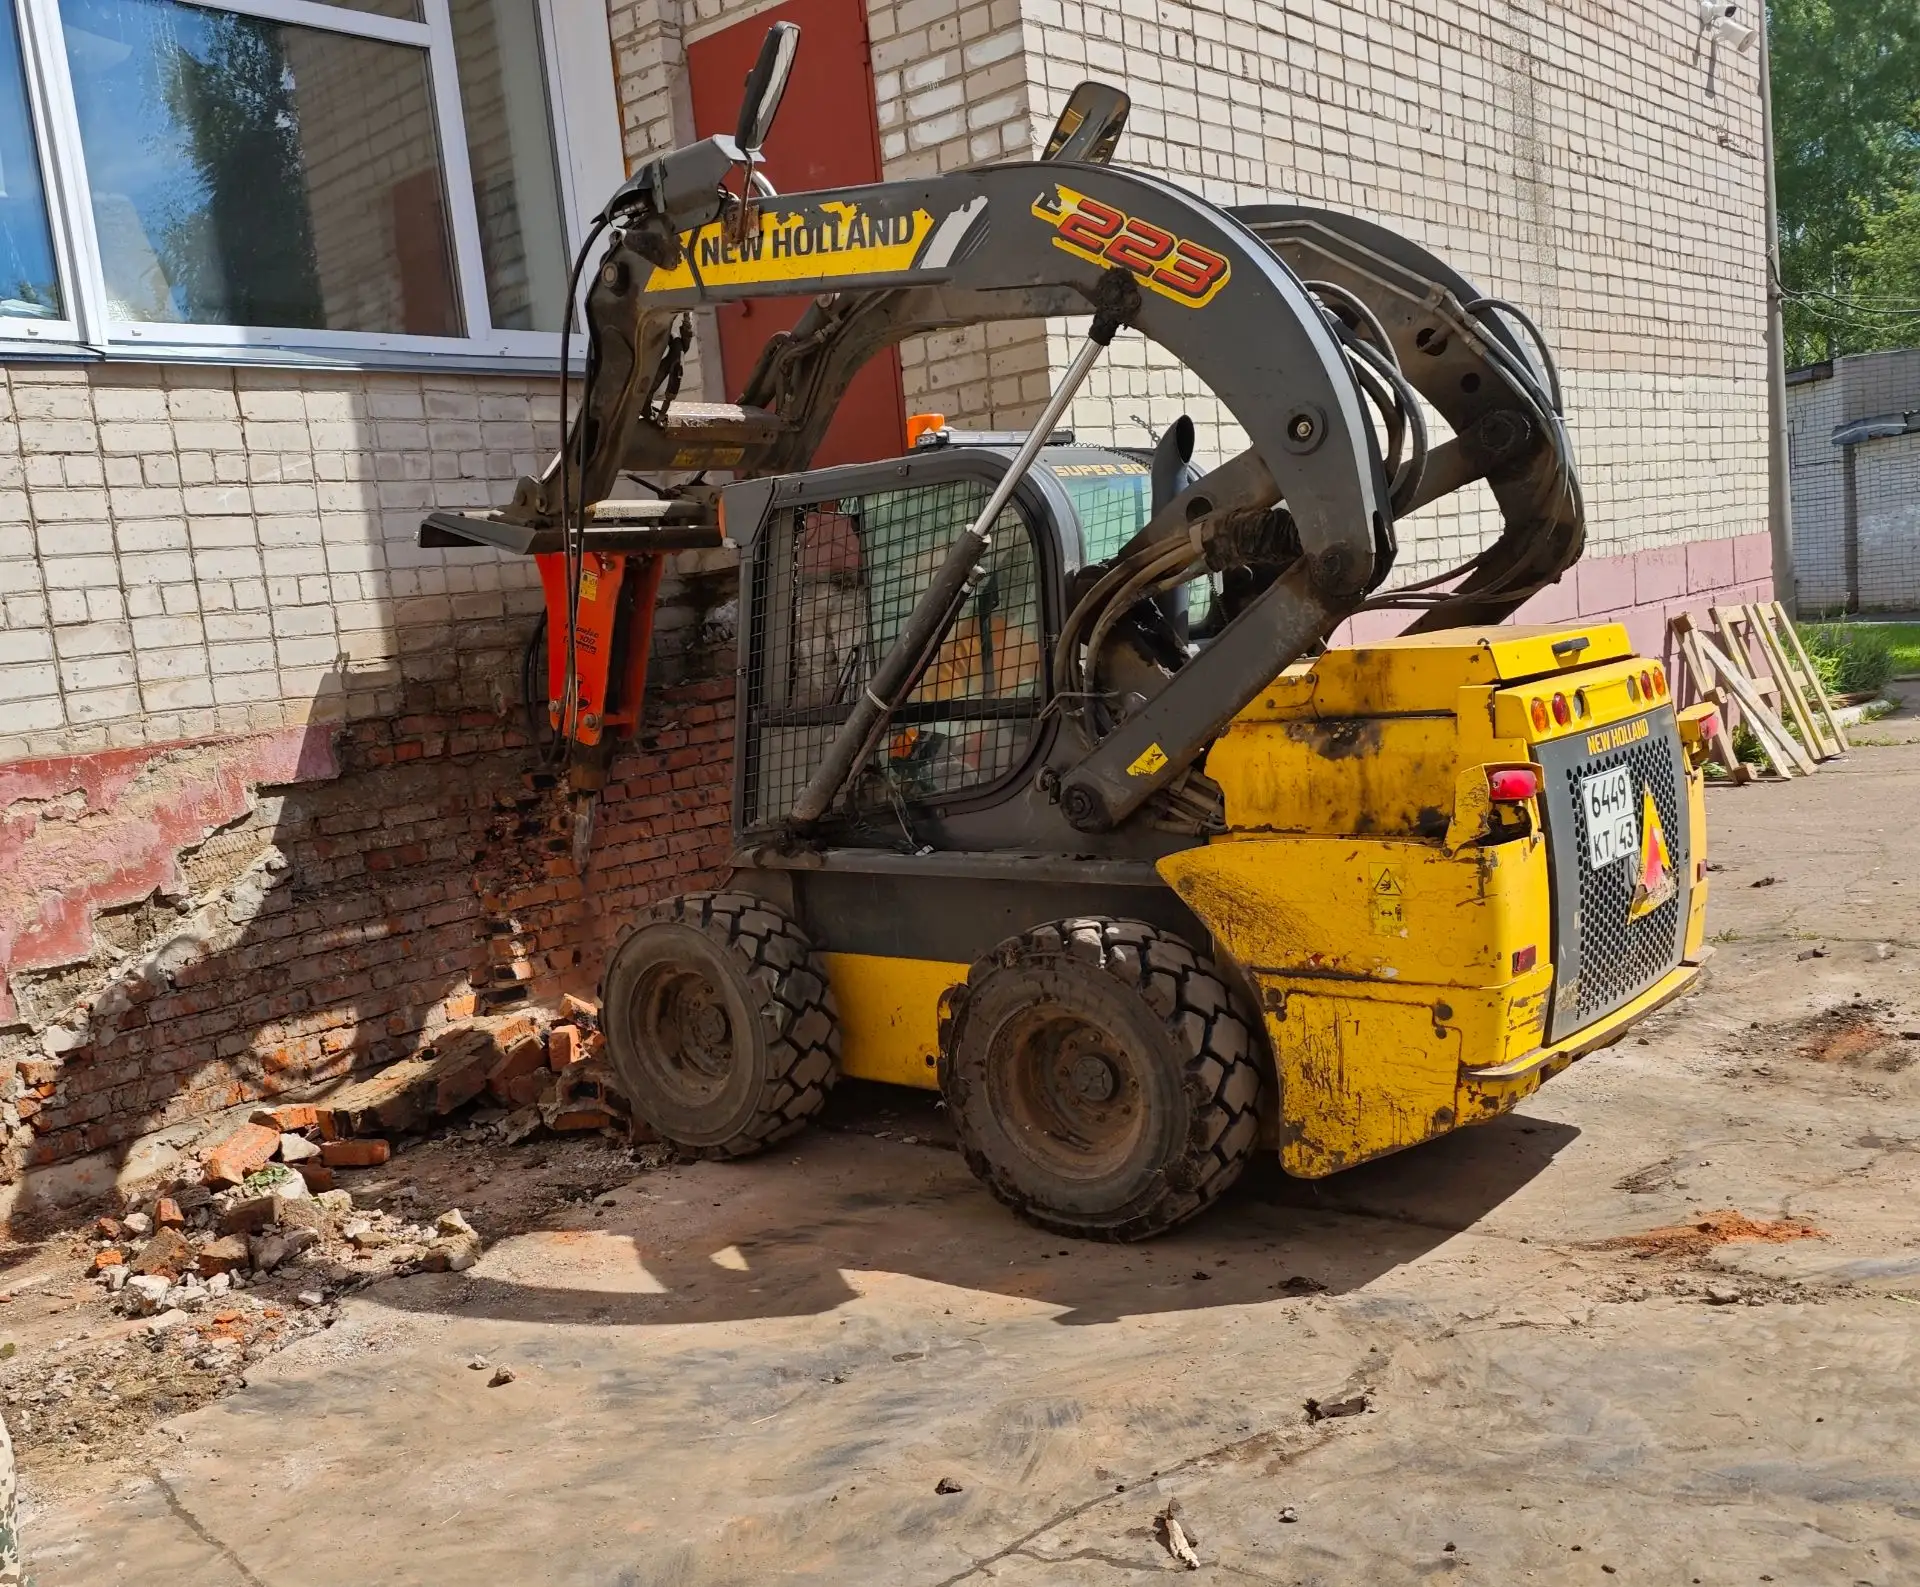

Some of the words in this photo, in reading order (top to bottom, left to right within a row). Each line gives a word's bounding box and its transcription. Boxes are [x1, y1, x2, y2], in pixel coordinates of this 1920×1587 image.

[701, 231, 764, 267] NEW
[772, 212, 915, 259] HOLLAND
[1052, 464, 1117, 477] SUPER
[1587, 730, 1611, 756] NEW
[1611, 718, 1650, 748] HOLLAND
[1591, 774, 1627, 819] 6449
[1619, 821, 1634, 850] 43
